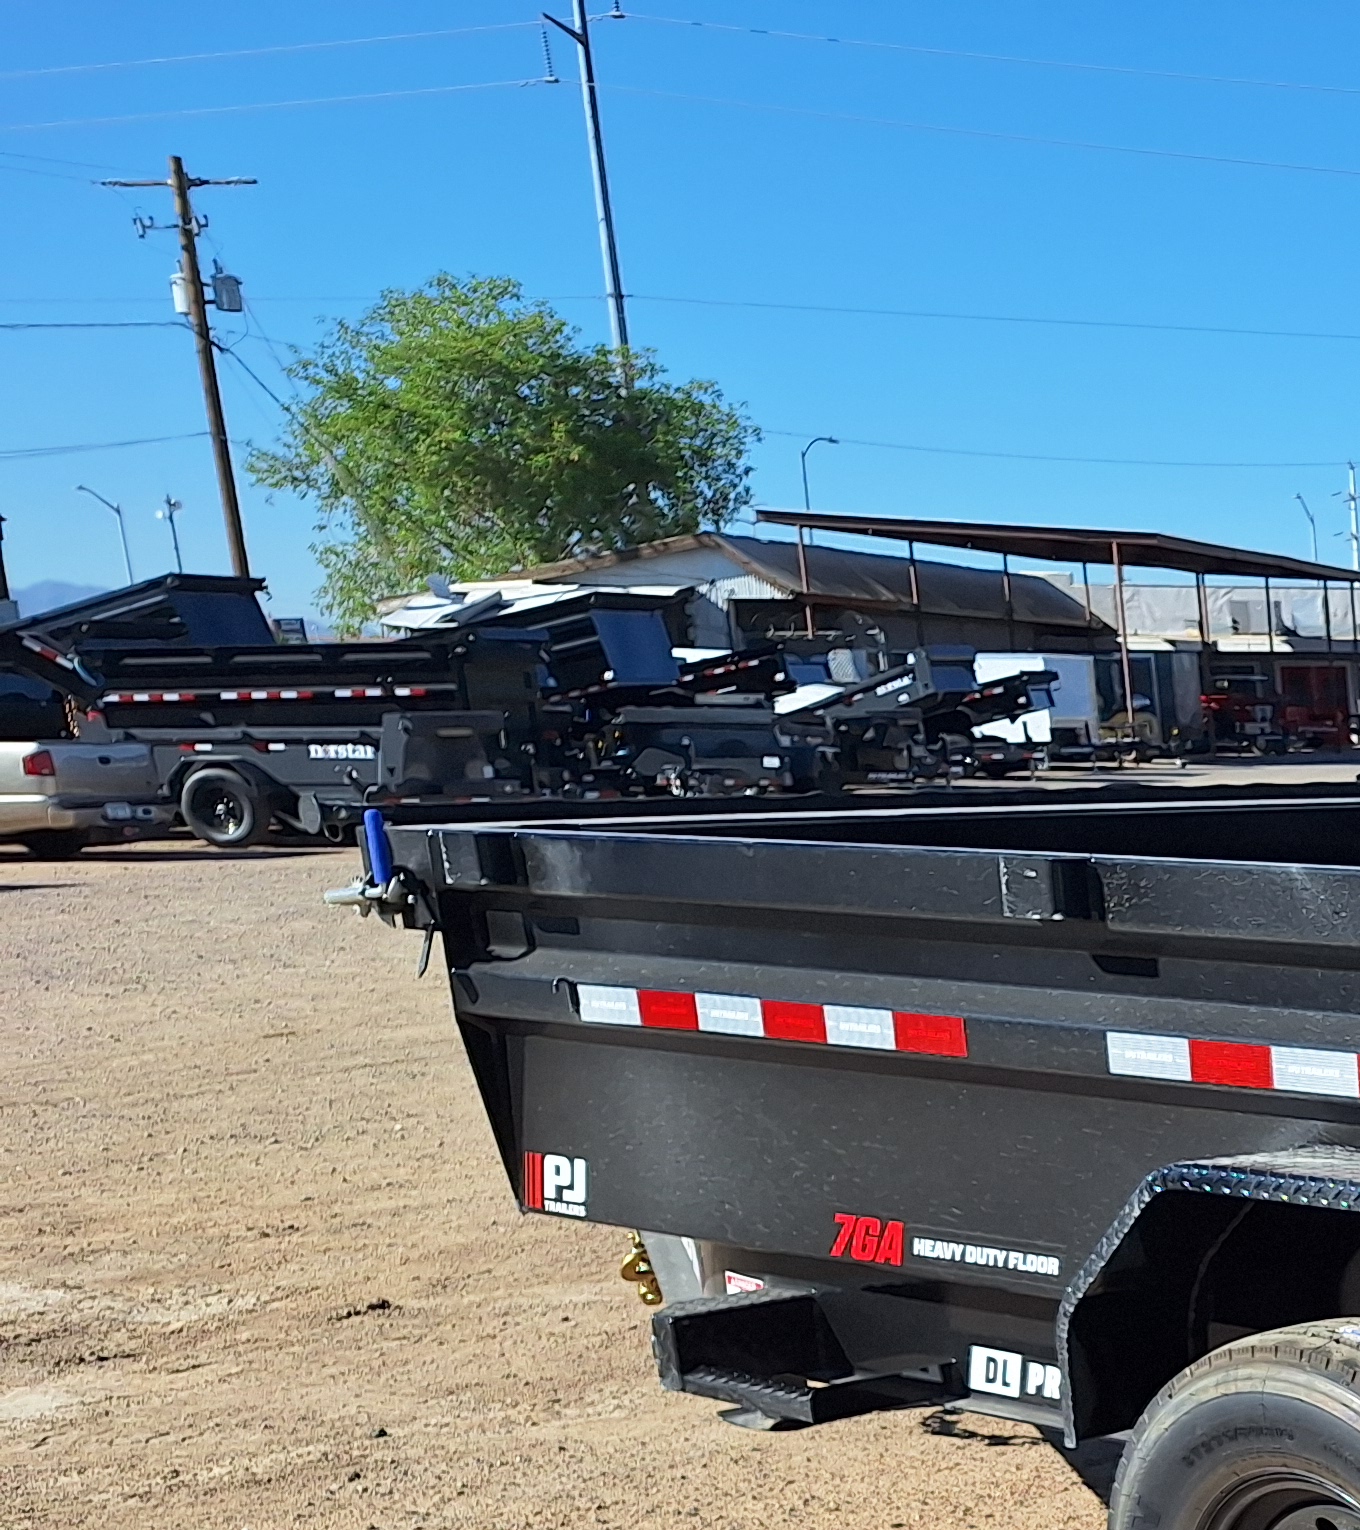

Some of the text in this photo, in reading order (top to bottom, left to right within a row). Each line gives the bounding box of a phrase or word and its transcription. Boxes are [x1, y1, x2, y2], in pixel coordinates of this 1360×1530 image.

[543, 1153, 588, 1204] PJ
[829, 1212, 1060, 1276] 7GA HEAVY DUTY FLOOR
[984, 1354, 1011, 1388] DL
